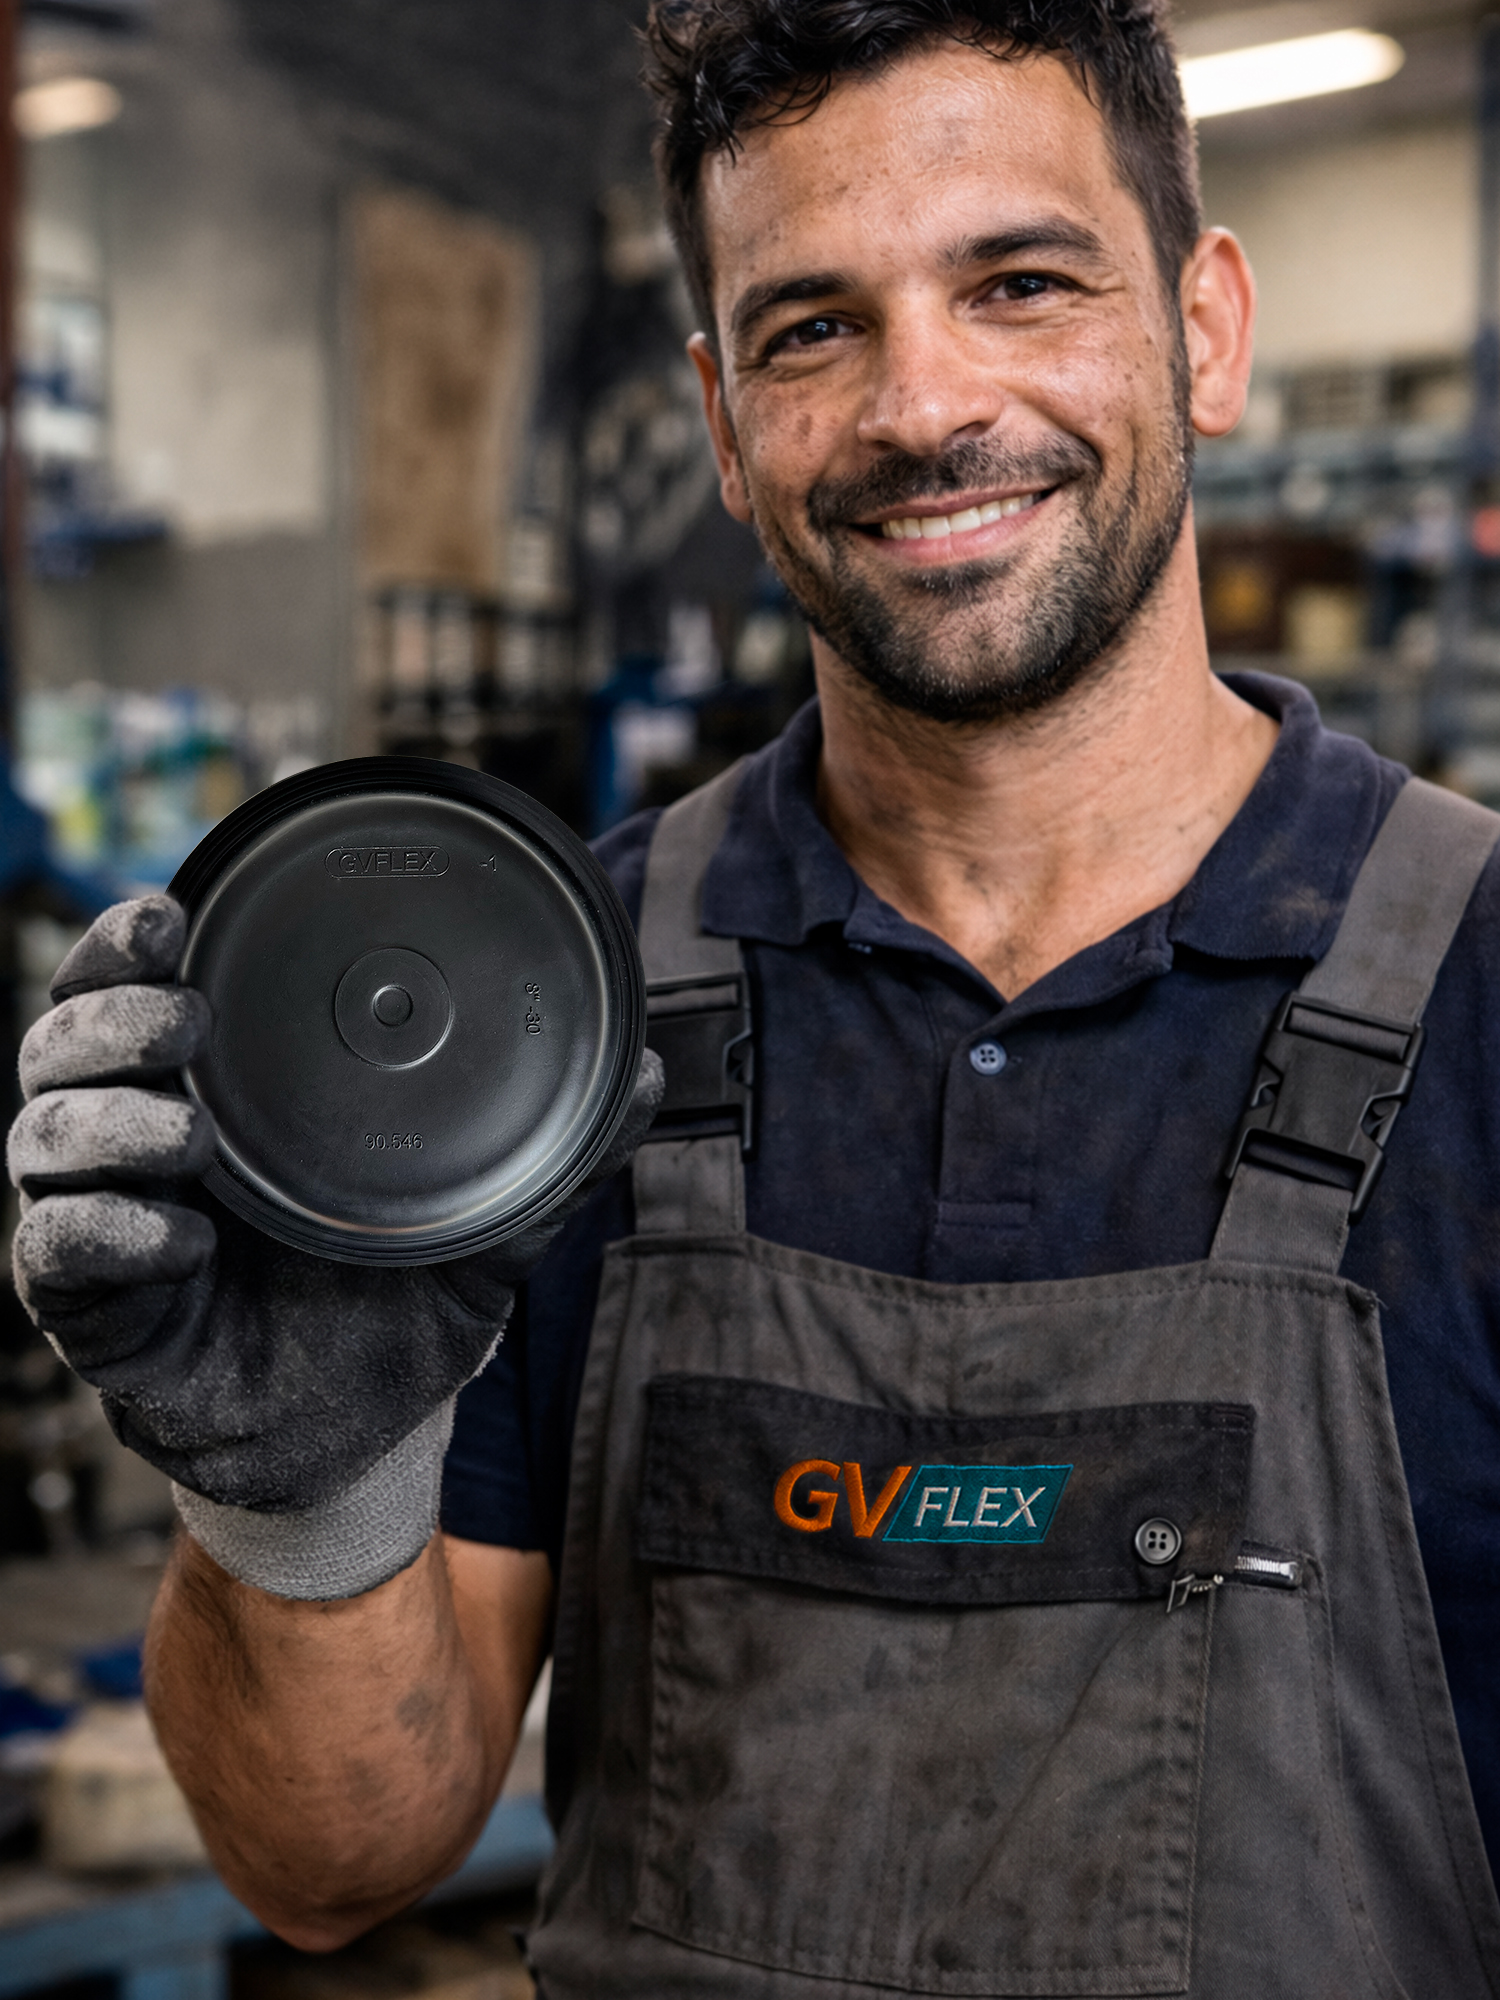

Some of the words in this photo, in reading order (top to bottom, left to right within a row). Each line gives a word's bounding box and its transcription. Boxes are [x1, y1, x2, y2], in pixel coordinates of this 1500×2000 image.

[339, 852, 437, 873] GVFLEX
[364, 1132, 423, 1150] 90.546
[774, 1459, 912, 1538] GV
[913, 1486, 1046, 1528] FLEX
